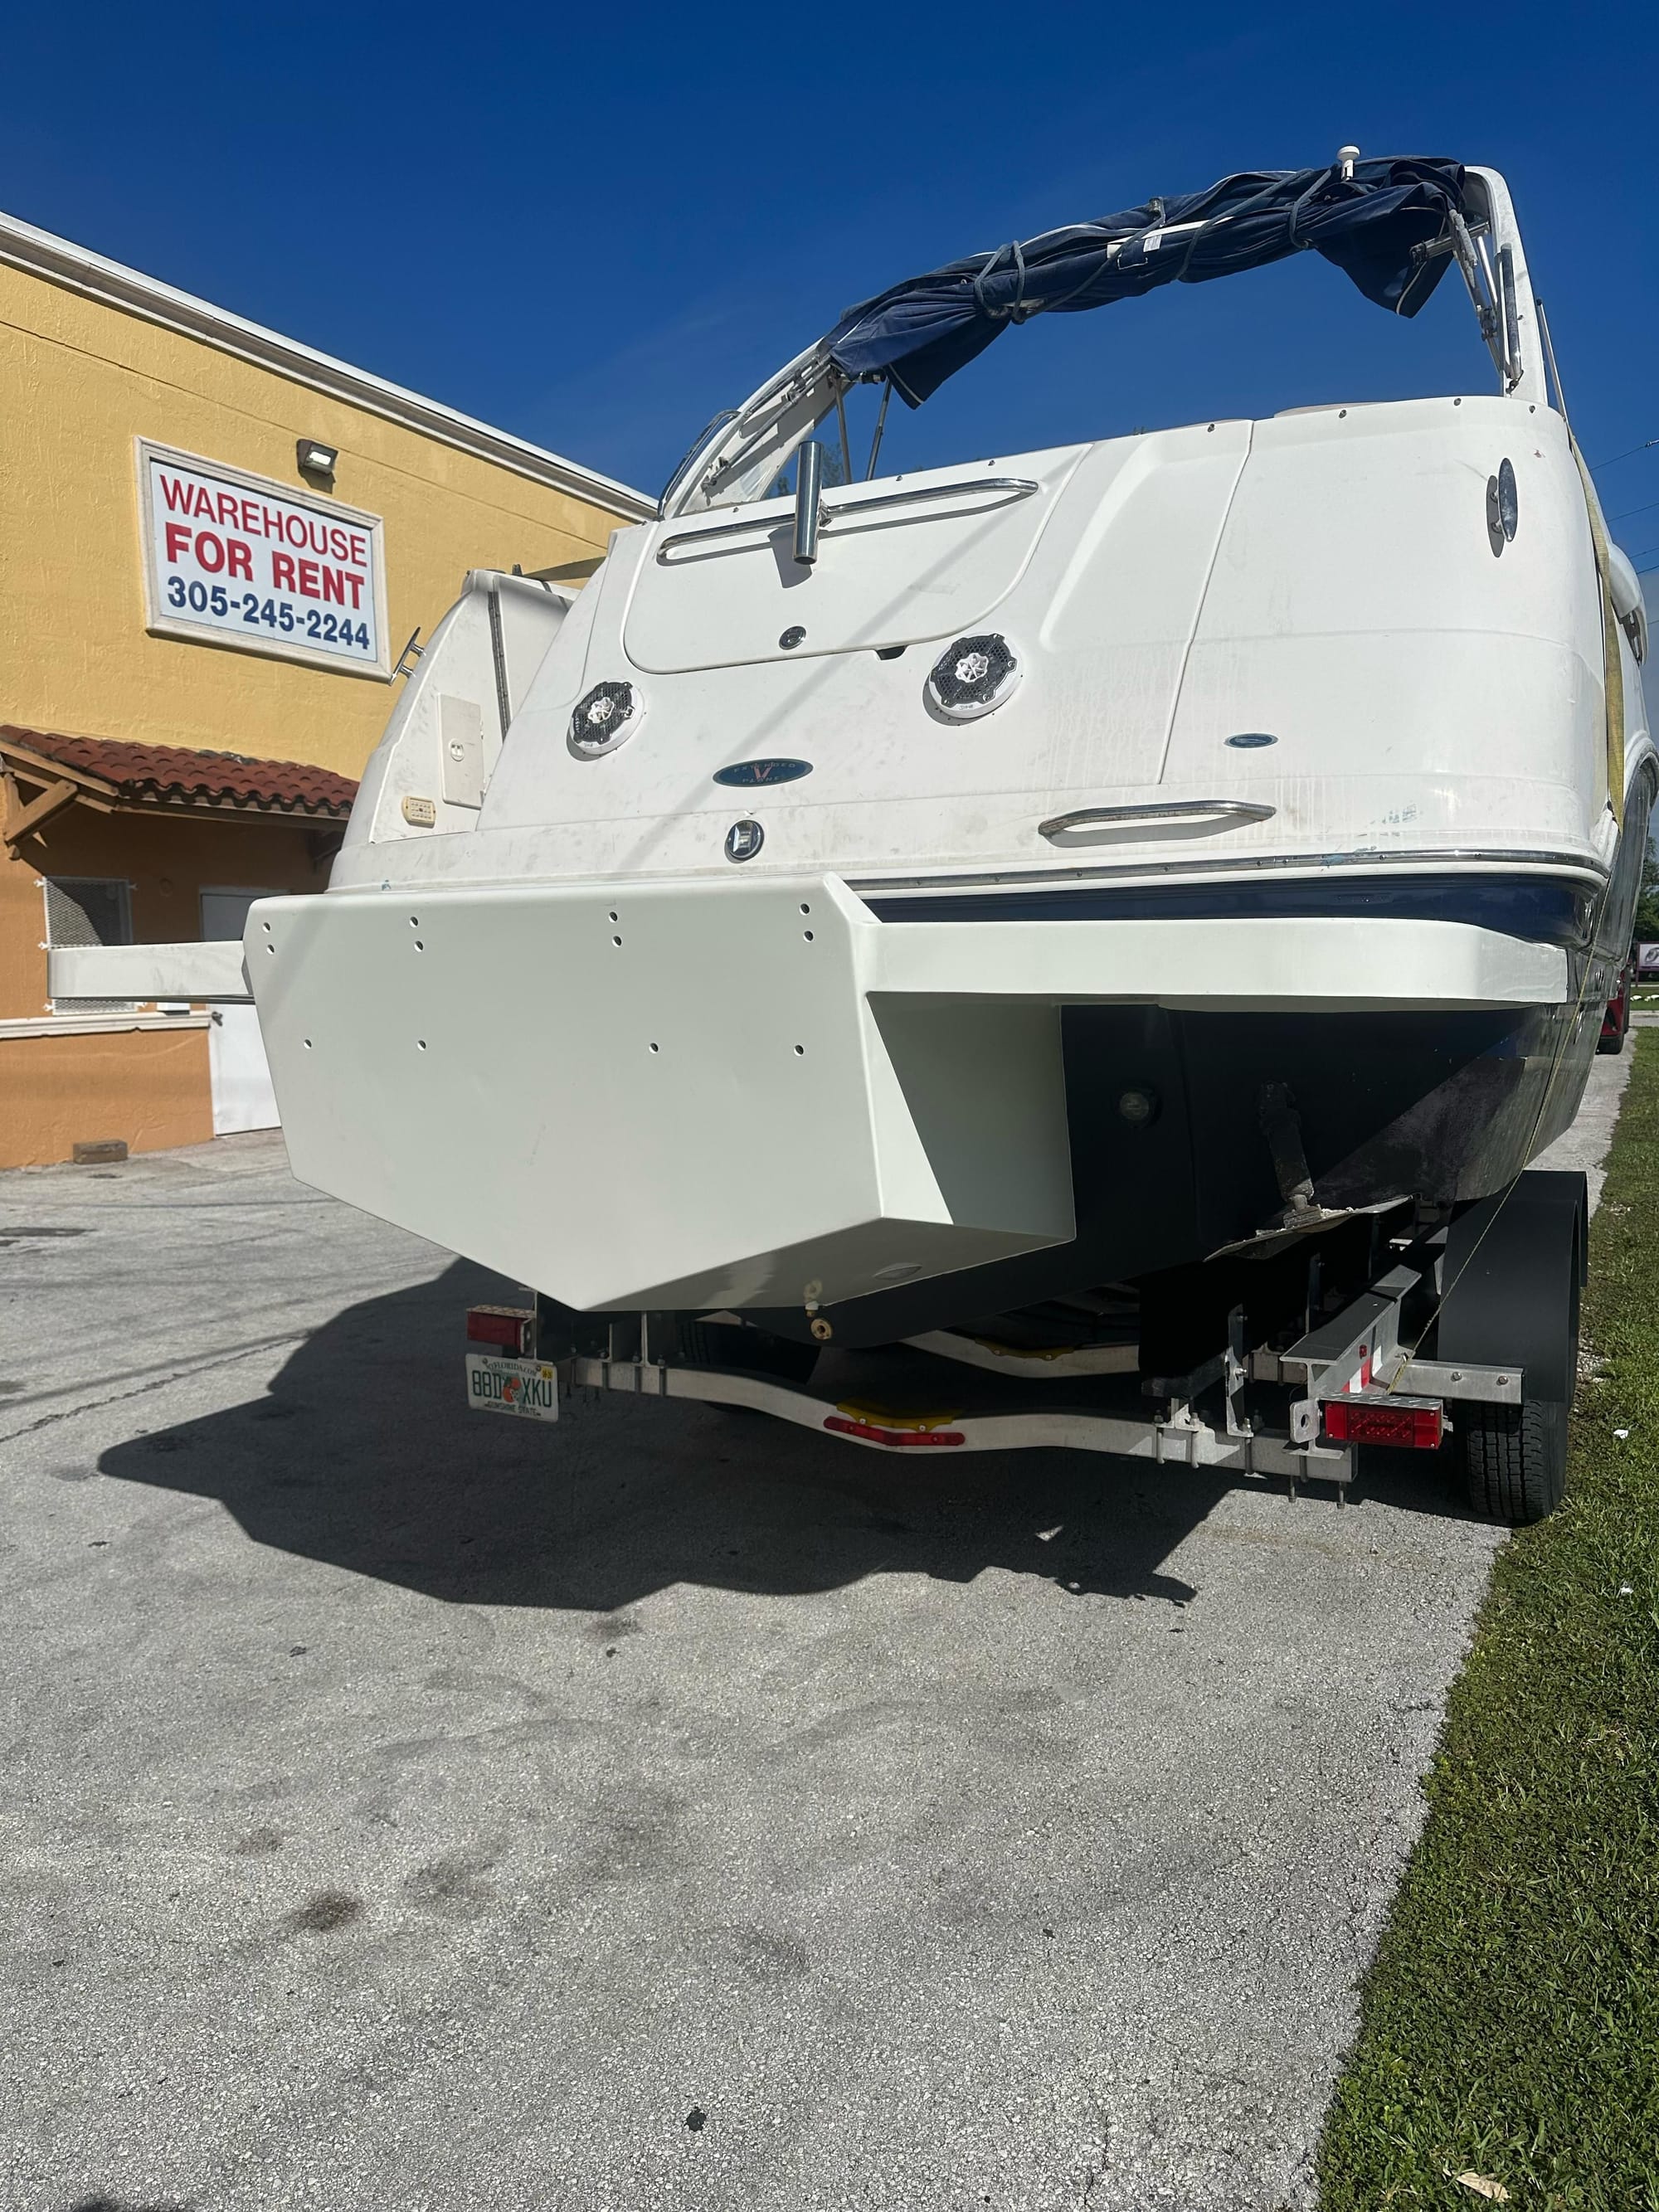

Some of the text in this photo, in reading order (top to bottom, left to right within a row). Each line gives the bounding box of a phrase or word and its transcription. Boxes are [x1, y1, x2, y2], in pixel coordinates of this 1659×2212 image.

[159, 474, 367, 567] WAREHOUSE
[165, 522, 365, 610] FOR RENT
[168, 576, 370, 649] 305-245-2244
[523, 1377, 552, 1407] XKU
